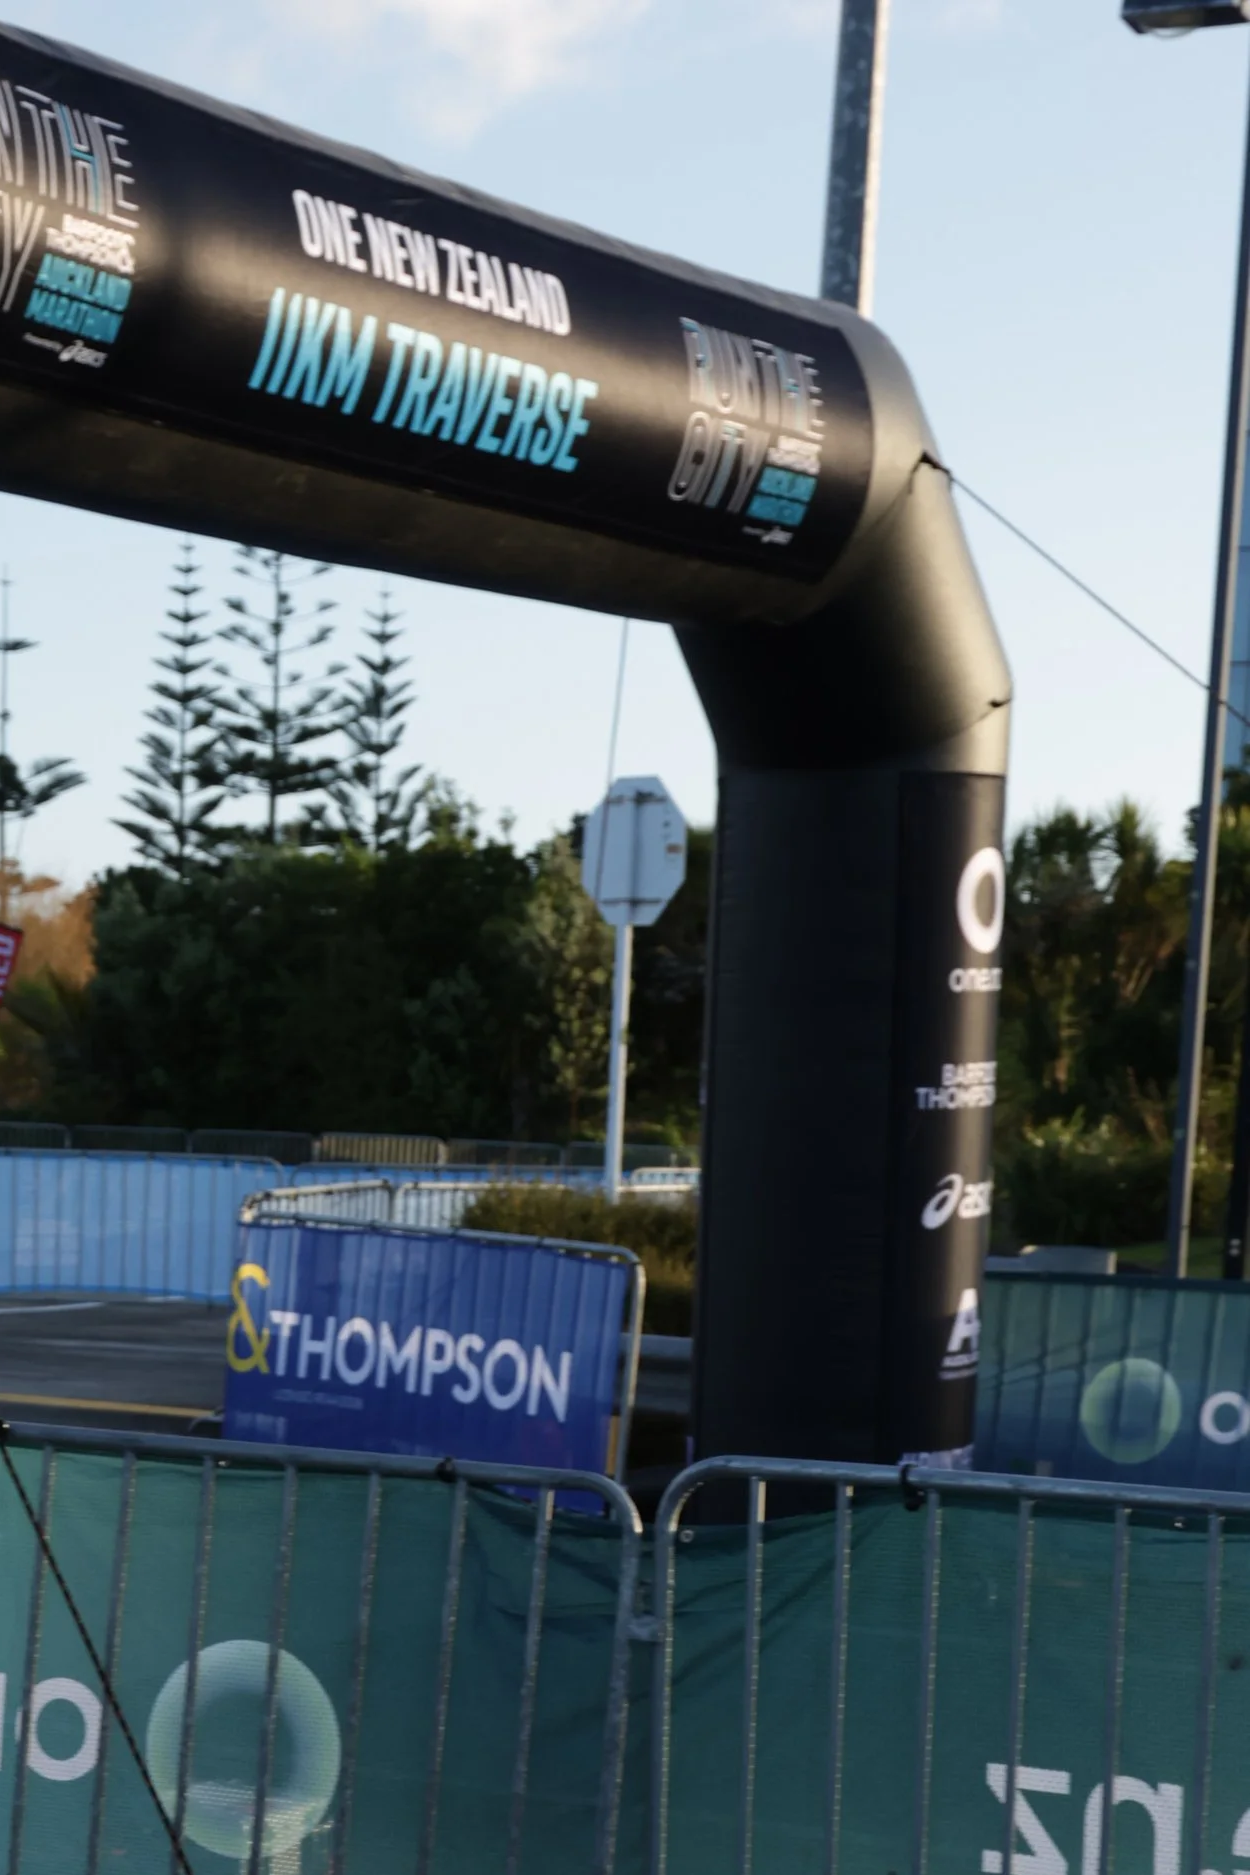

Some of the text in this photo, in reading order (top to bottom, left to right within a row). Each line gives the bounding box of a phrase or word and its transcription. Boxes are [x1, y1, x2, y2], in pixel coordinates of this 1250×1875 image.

[16, 85, 140, 229] THE
[292, 188, 571, 336] ONE NEW ZEALAND
[248, 286, 598, 473] 11KM TRAVERSE
[226, 1262, 573, 1424] & THOMPSON
